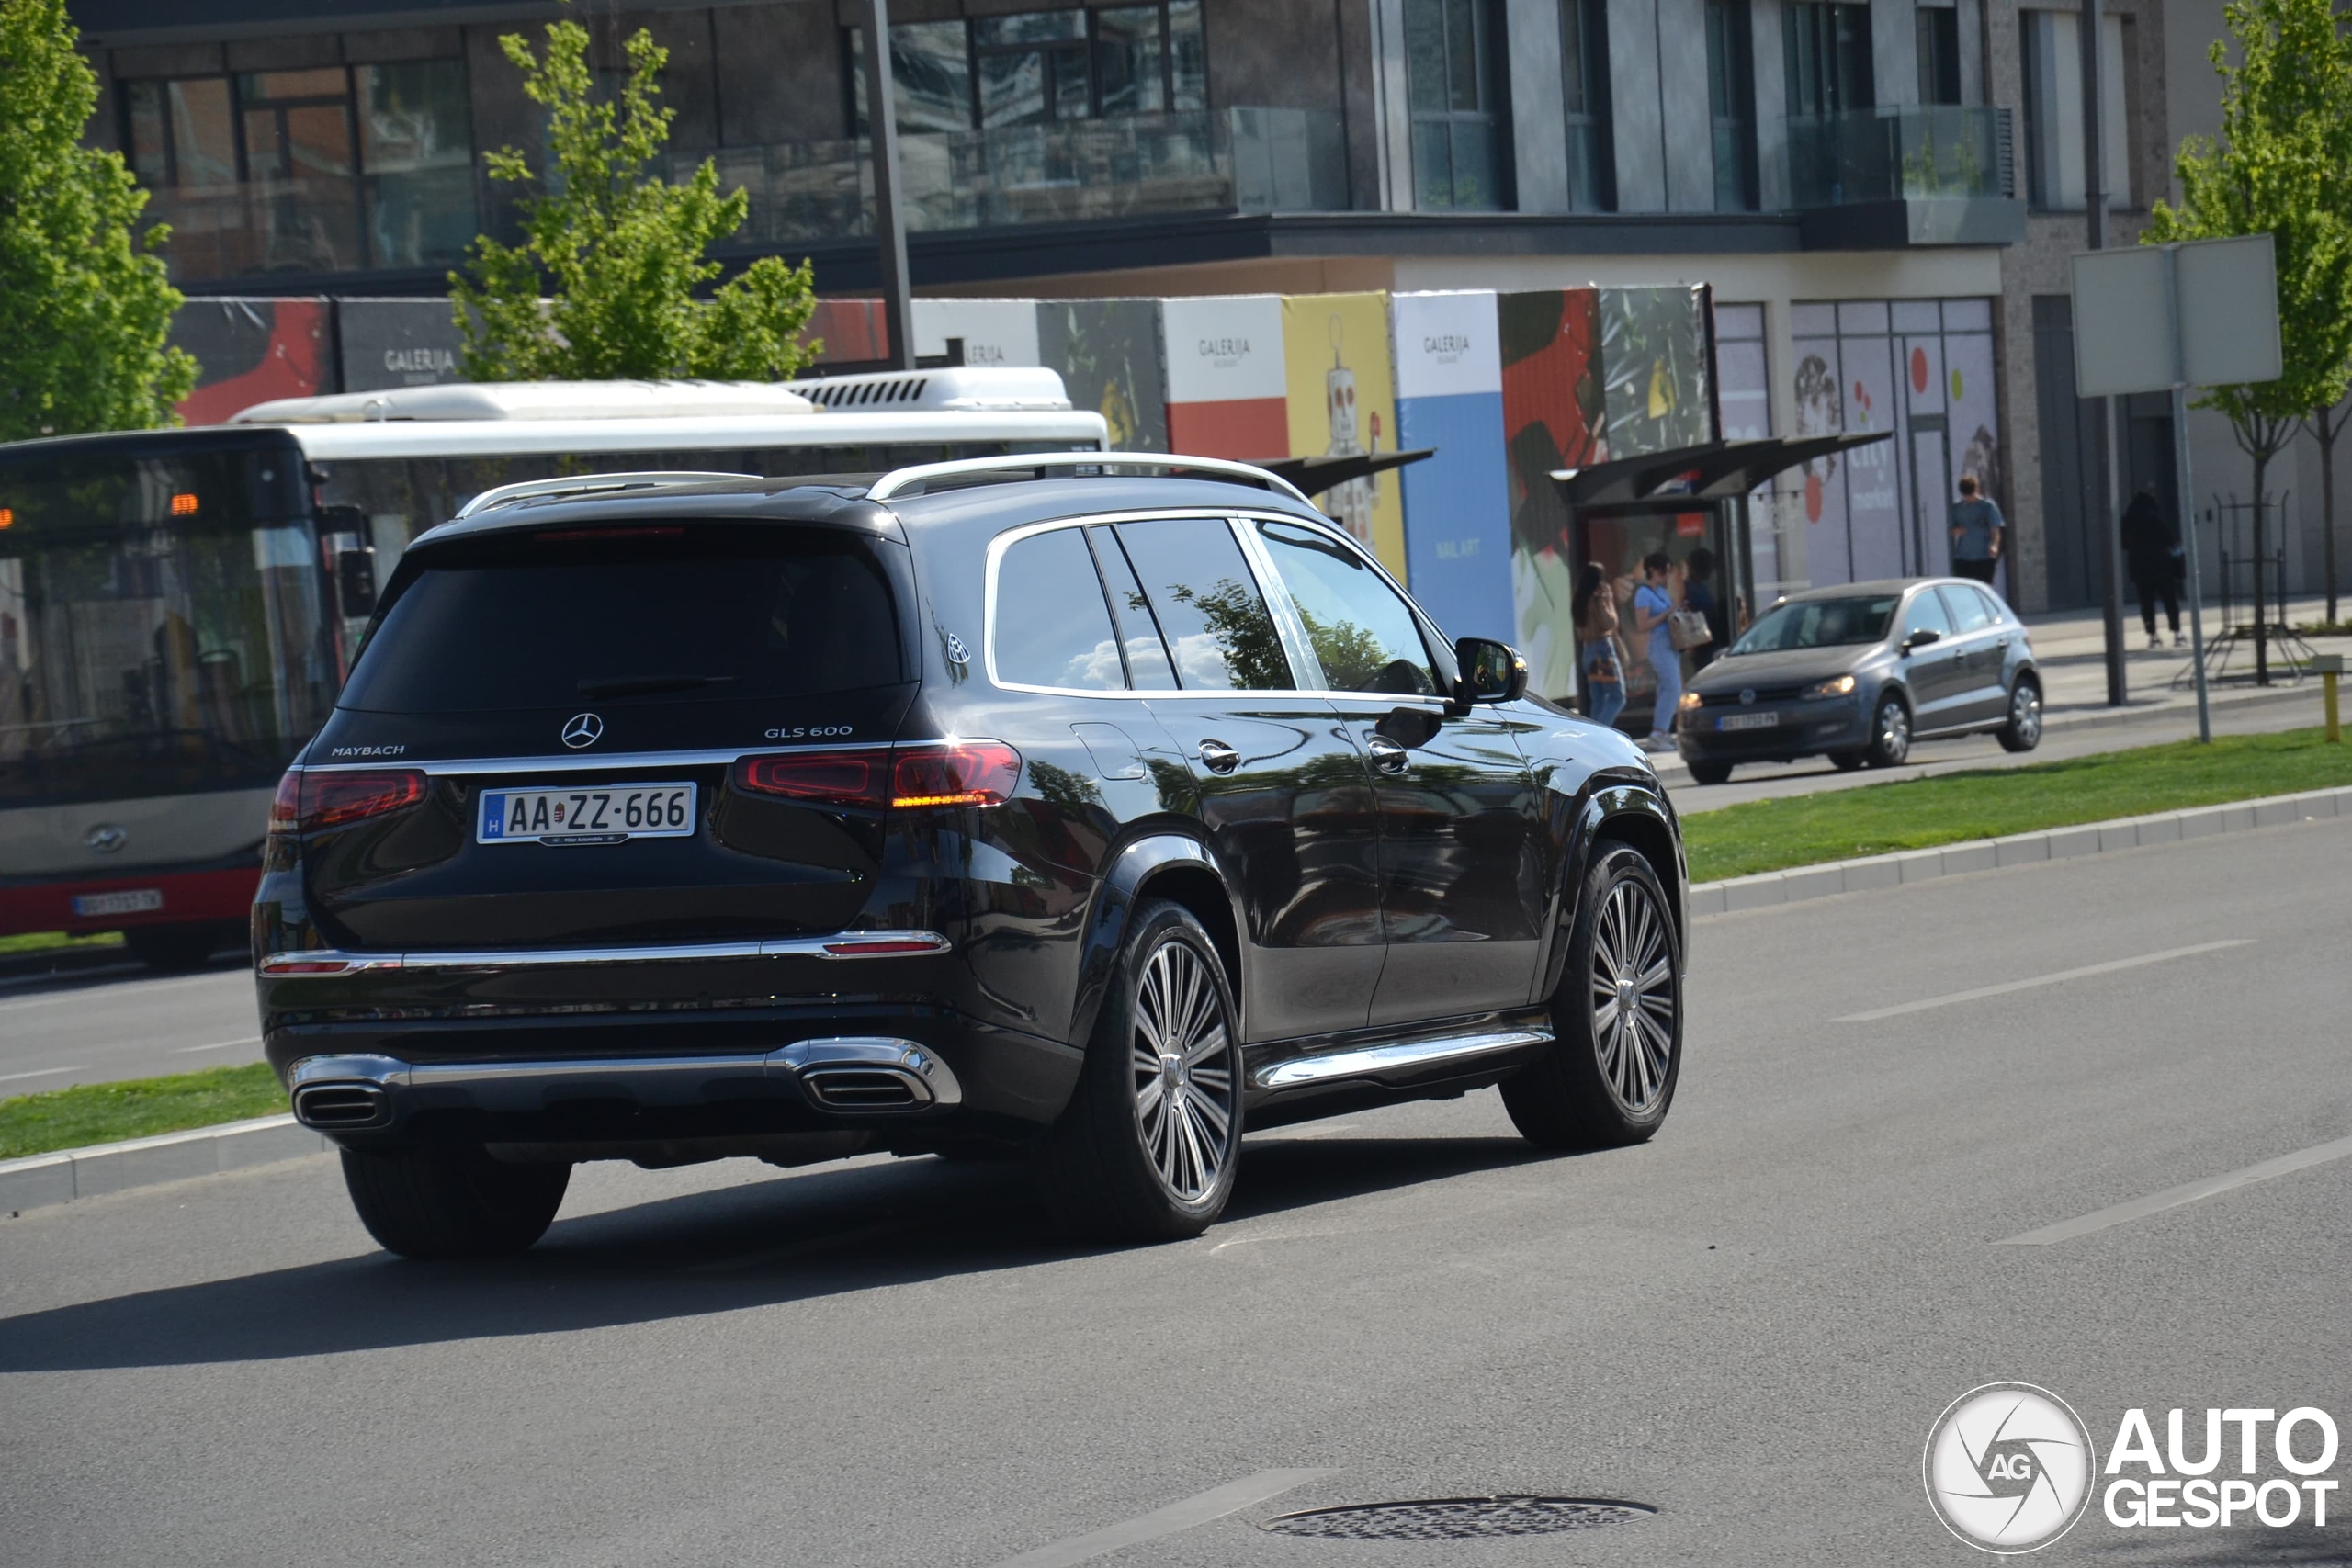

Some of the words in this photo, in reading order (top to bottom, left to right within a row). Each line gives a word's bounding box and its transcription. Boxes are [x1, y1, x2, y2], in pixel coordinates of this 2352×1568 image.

[964, 344, 1005, 366] LERIJA
[1198, 337, 1251, 359] GALERIJA
[1423, 334, 1470, 356] GALERIJA
[385, 348, 456, 376] GALERIJA
[764, 728, 805, 739] GLS
[809, 726, 853, 737] 600
[332, 745, 405, 756] MAYBACH
[509, 796, 549, 832] AA
[567, 792, 684, 829] ZZ-666
[489, 819, 499, 832] H
